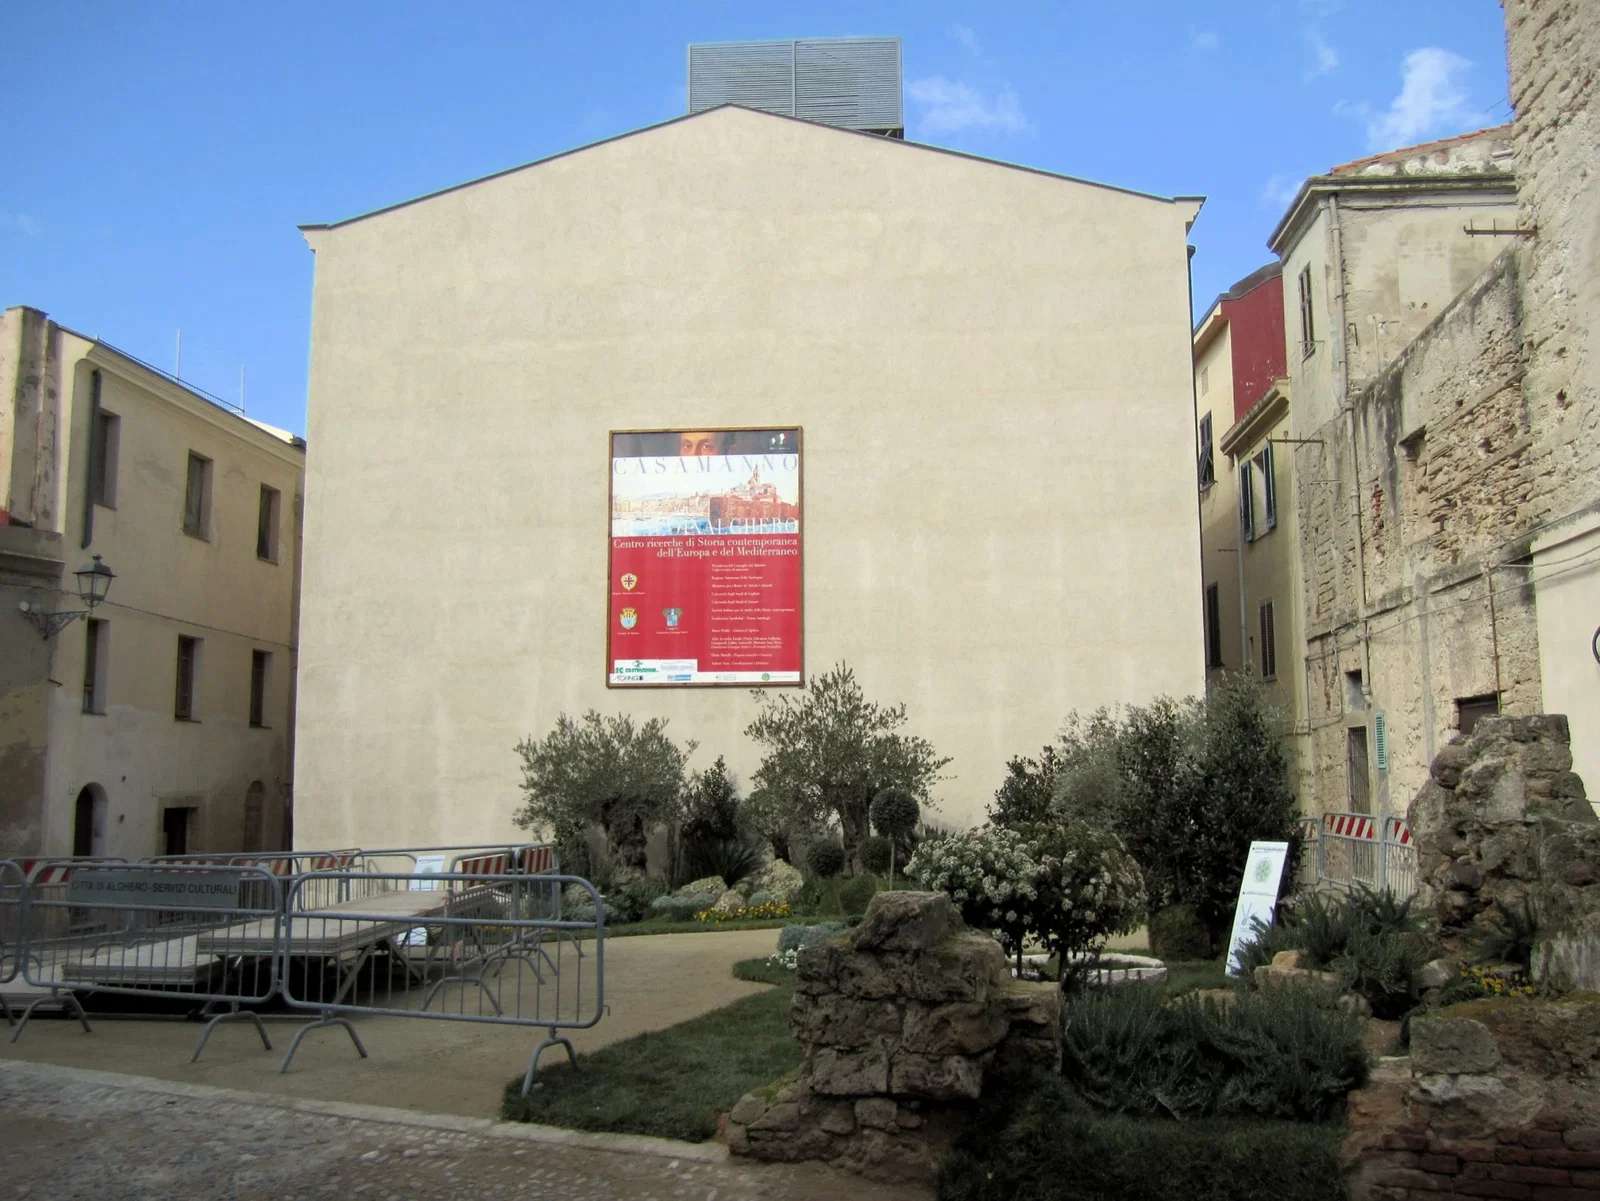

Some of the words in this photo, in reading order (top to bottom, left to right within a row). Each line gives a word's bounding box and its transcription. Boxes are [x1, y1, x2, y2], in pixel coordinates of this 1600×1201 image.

[613, 454, 798, 475] CASAMANNO
[613, 538, 645, 549] Centro
[647, 537, 684, 548] ricerche
[686, 537, 695, 547] di
[697, 536, 726, 547] Storia
[727, 535, 798, 548] contemporanea
[656, 547, 710, 559] dell'Europa
[720, 547, 735, 556] del
[737, 545, 798, 556] Mediterraneo
[96, 881, 105, 891] DI
[188, 883, 237, 895] CULTURALI
